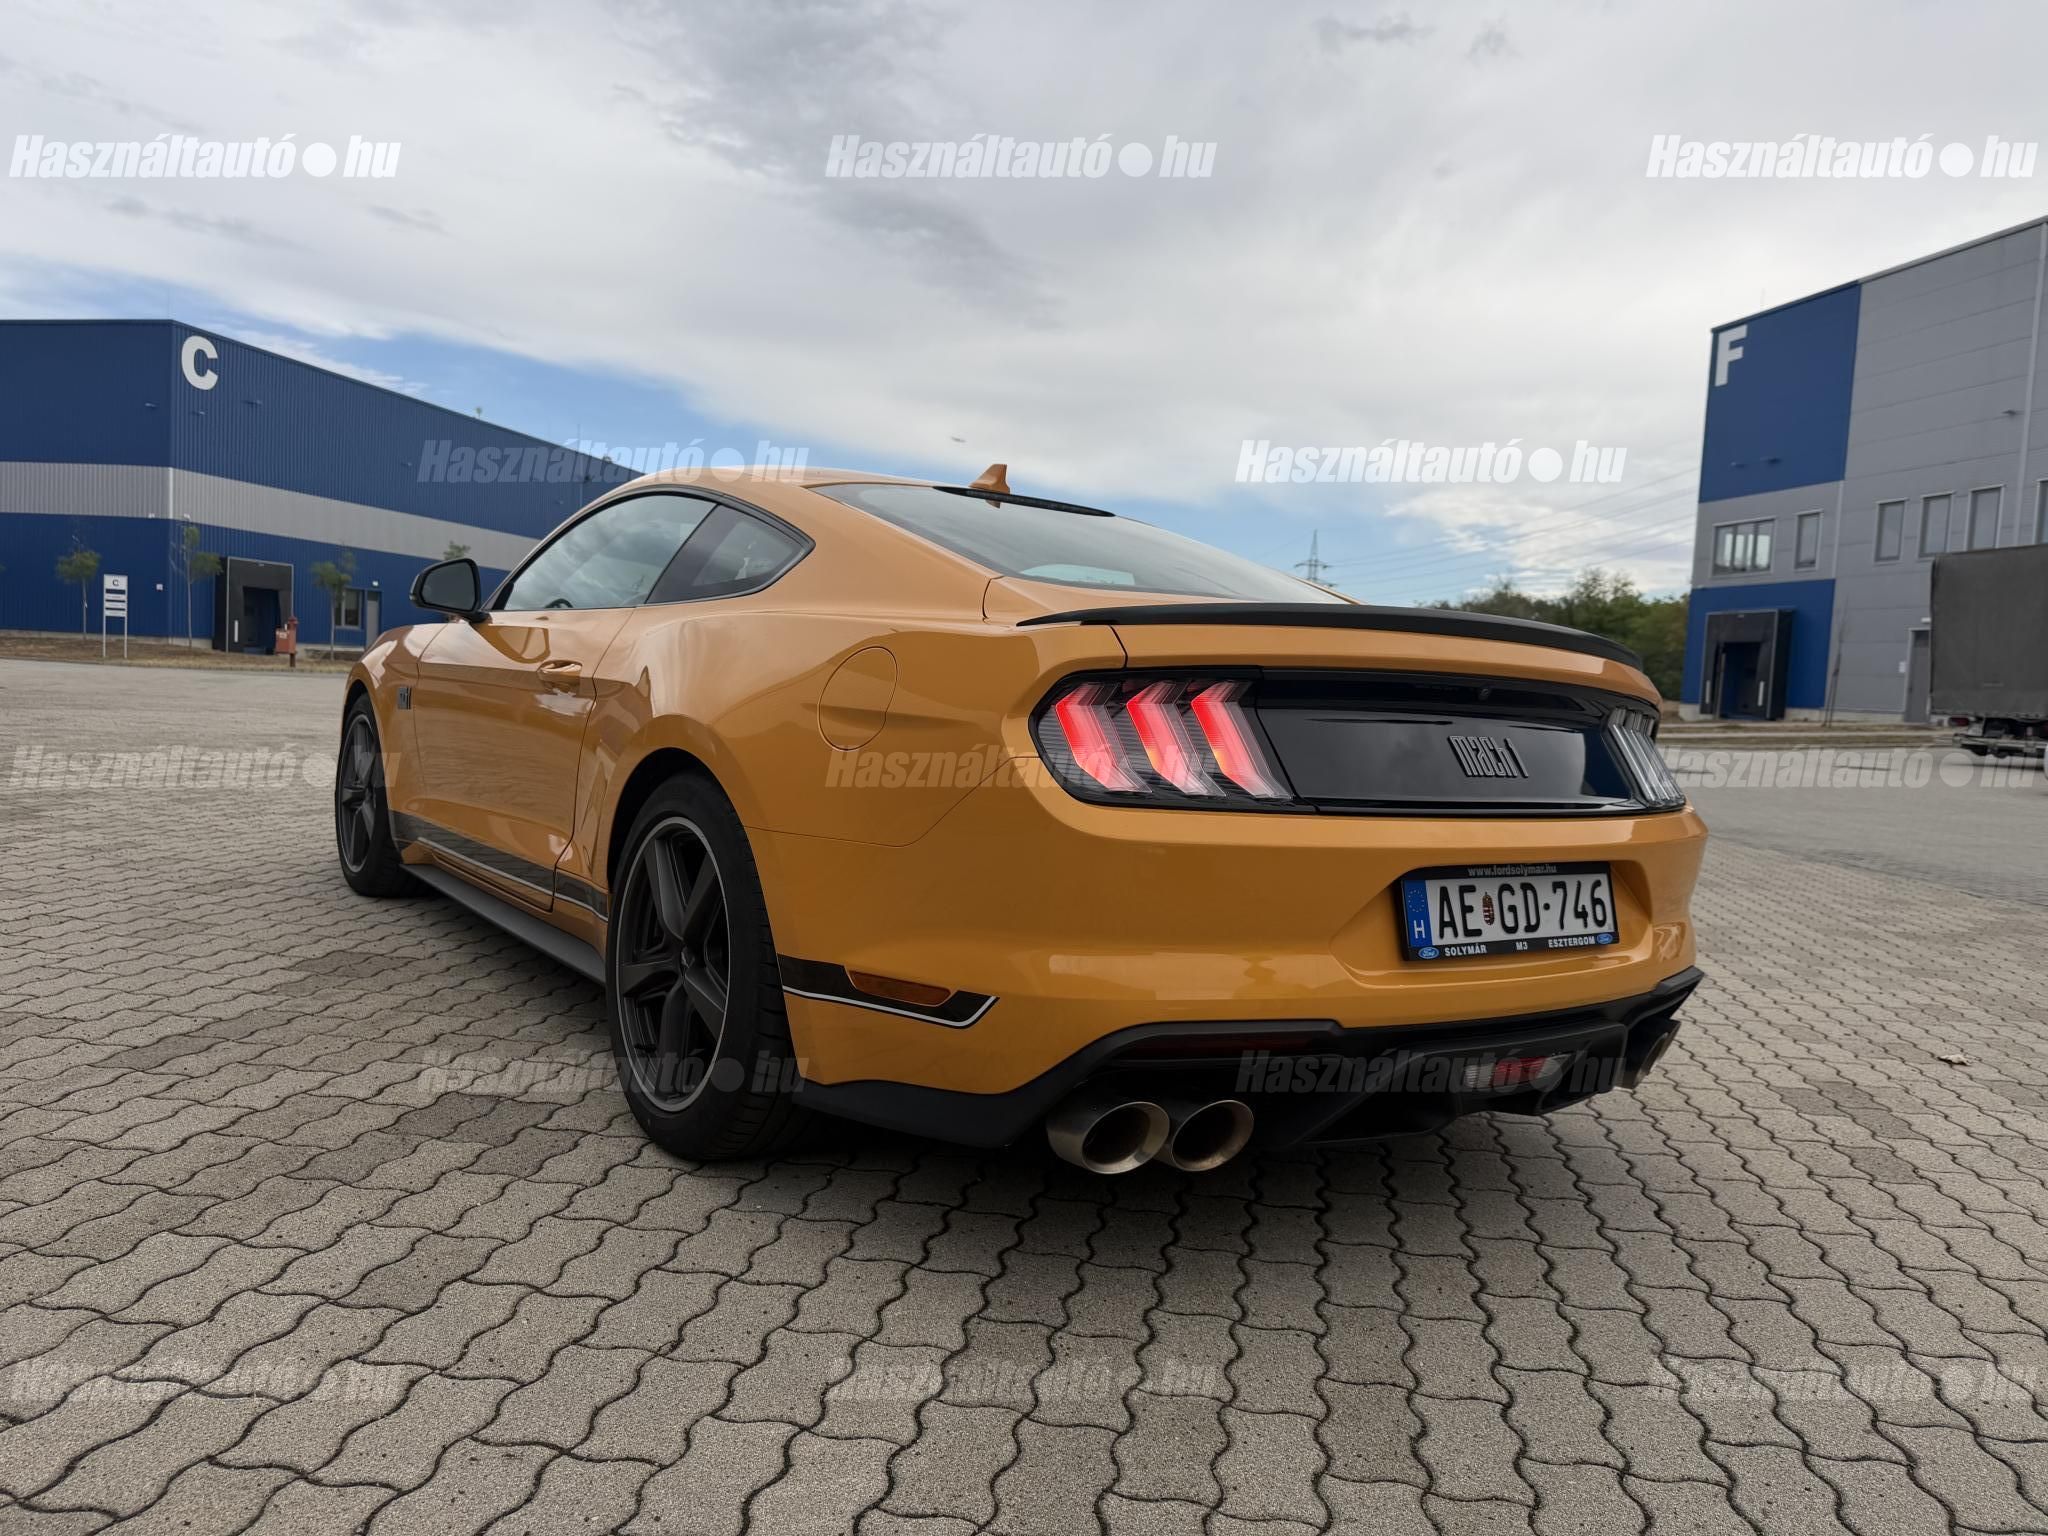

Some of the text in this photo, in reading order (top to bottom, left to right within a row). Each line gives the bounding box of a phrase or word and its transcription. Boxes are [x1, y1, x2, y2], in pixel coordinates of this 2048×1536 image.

[181, 335, 218, 390] C
[1714, 325, 1747, 387] F
[1413, 920, 1426, 939] H
[1438, 884, 1483, 940] AE
[1445, 943, 1488, 956] SOLYMÁR
[1515, 941, 1529, 951] M3
[1548, 936, 1596, 948] ESZTERGOM
